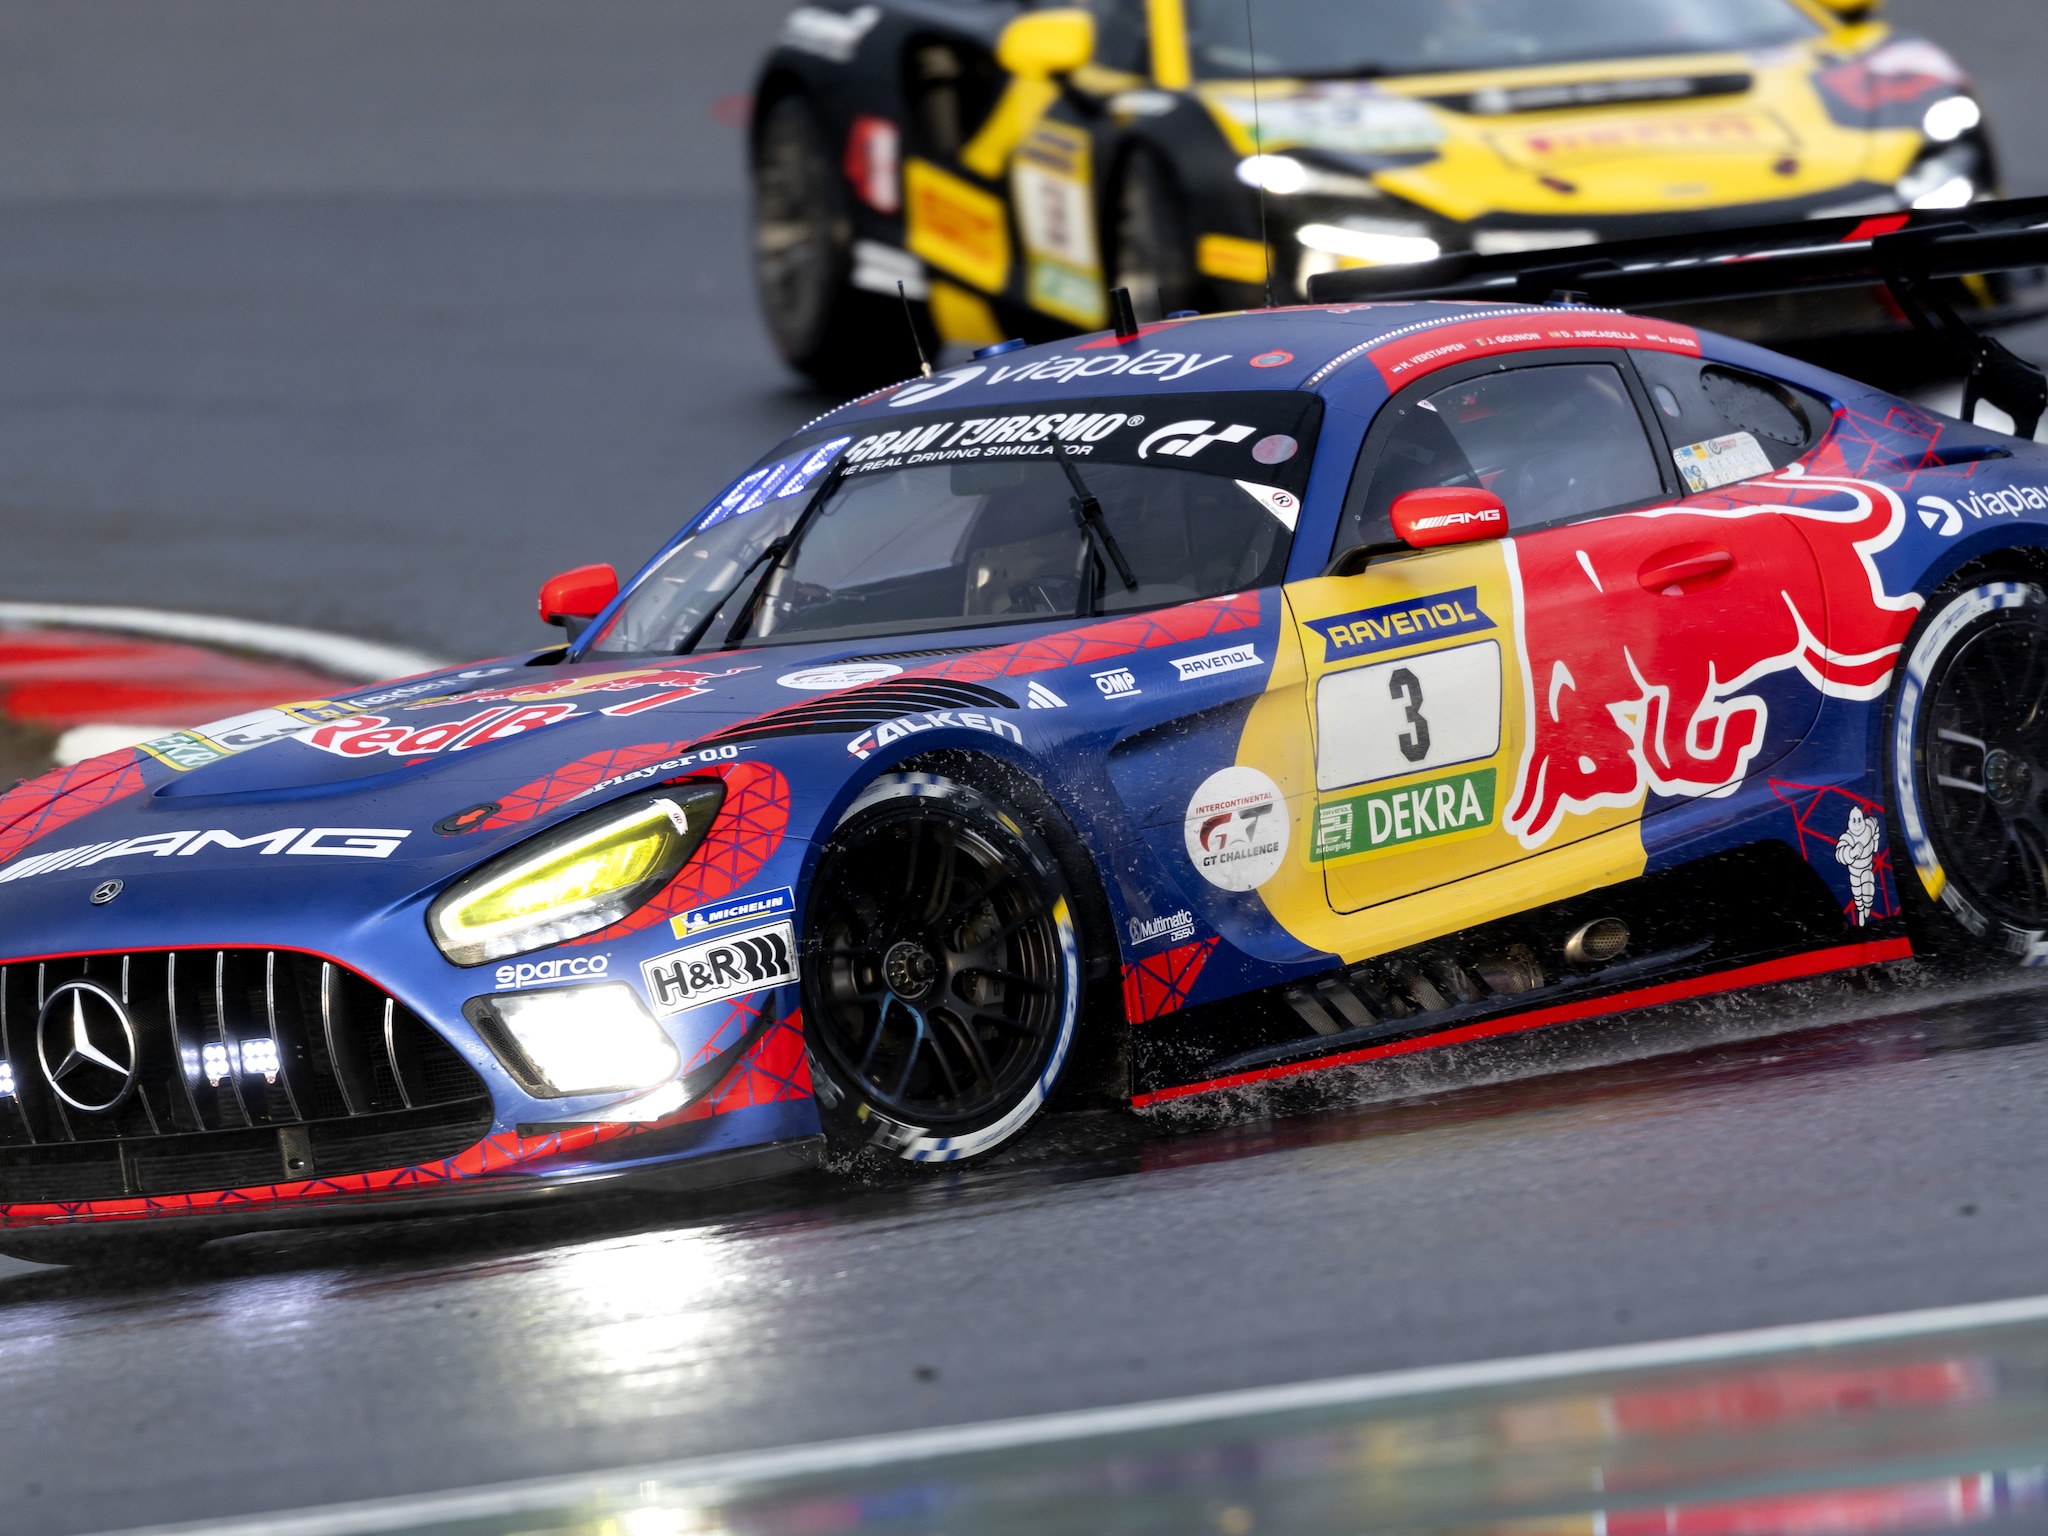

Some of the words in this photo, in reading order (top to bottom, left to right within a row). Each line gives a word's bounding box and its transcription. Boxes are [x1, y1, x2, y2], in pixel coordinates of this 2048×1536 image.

[1409, 342, 1466, 364] VERSTAPPEN
[1496, 332, 1541, 343] GOUNON
[1574, 330, 1639, 340] JUNCADELLA
[1668, 336, 1697, 347] AUER
[985, 348, 1233, 383] viaplay
[845, 422, 953, 463] GRAN
[862, 456, 902, 473] REAL
[907, 447, 981, 465] DRIVING
[984, 445, 1093, 457] SIMULAOR
[1327, 600, 1477, 648] RAVENOL
[1182, 650, 1253, 674] RAVENOL
[1095, 671, 1137, 696] OMP
[1388, 667, 1431, 762] 3
[846, 711, 1023, 760] FALKEN
[592, 754, 697, 794] Player
[1196, 791, 1273, 814] INTERCONTINENTAL
[1367, 778, 1485, 845] DEKRA
[1203, 854, 1218, 867] GT
[1219, 841, 1280, 864] CHALLENGE
[709, 896, 783, 922] MICHELIN
[1140, 908, 1193, 938] Multimatic
[496, 954, 608, 988] sparco
[653, 948, 742, 1002] H&R
